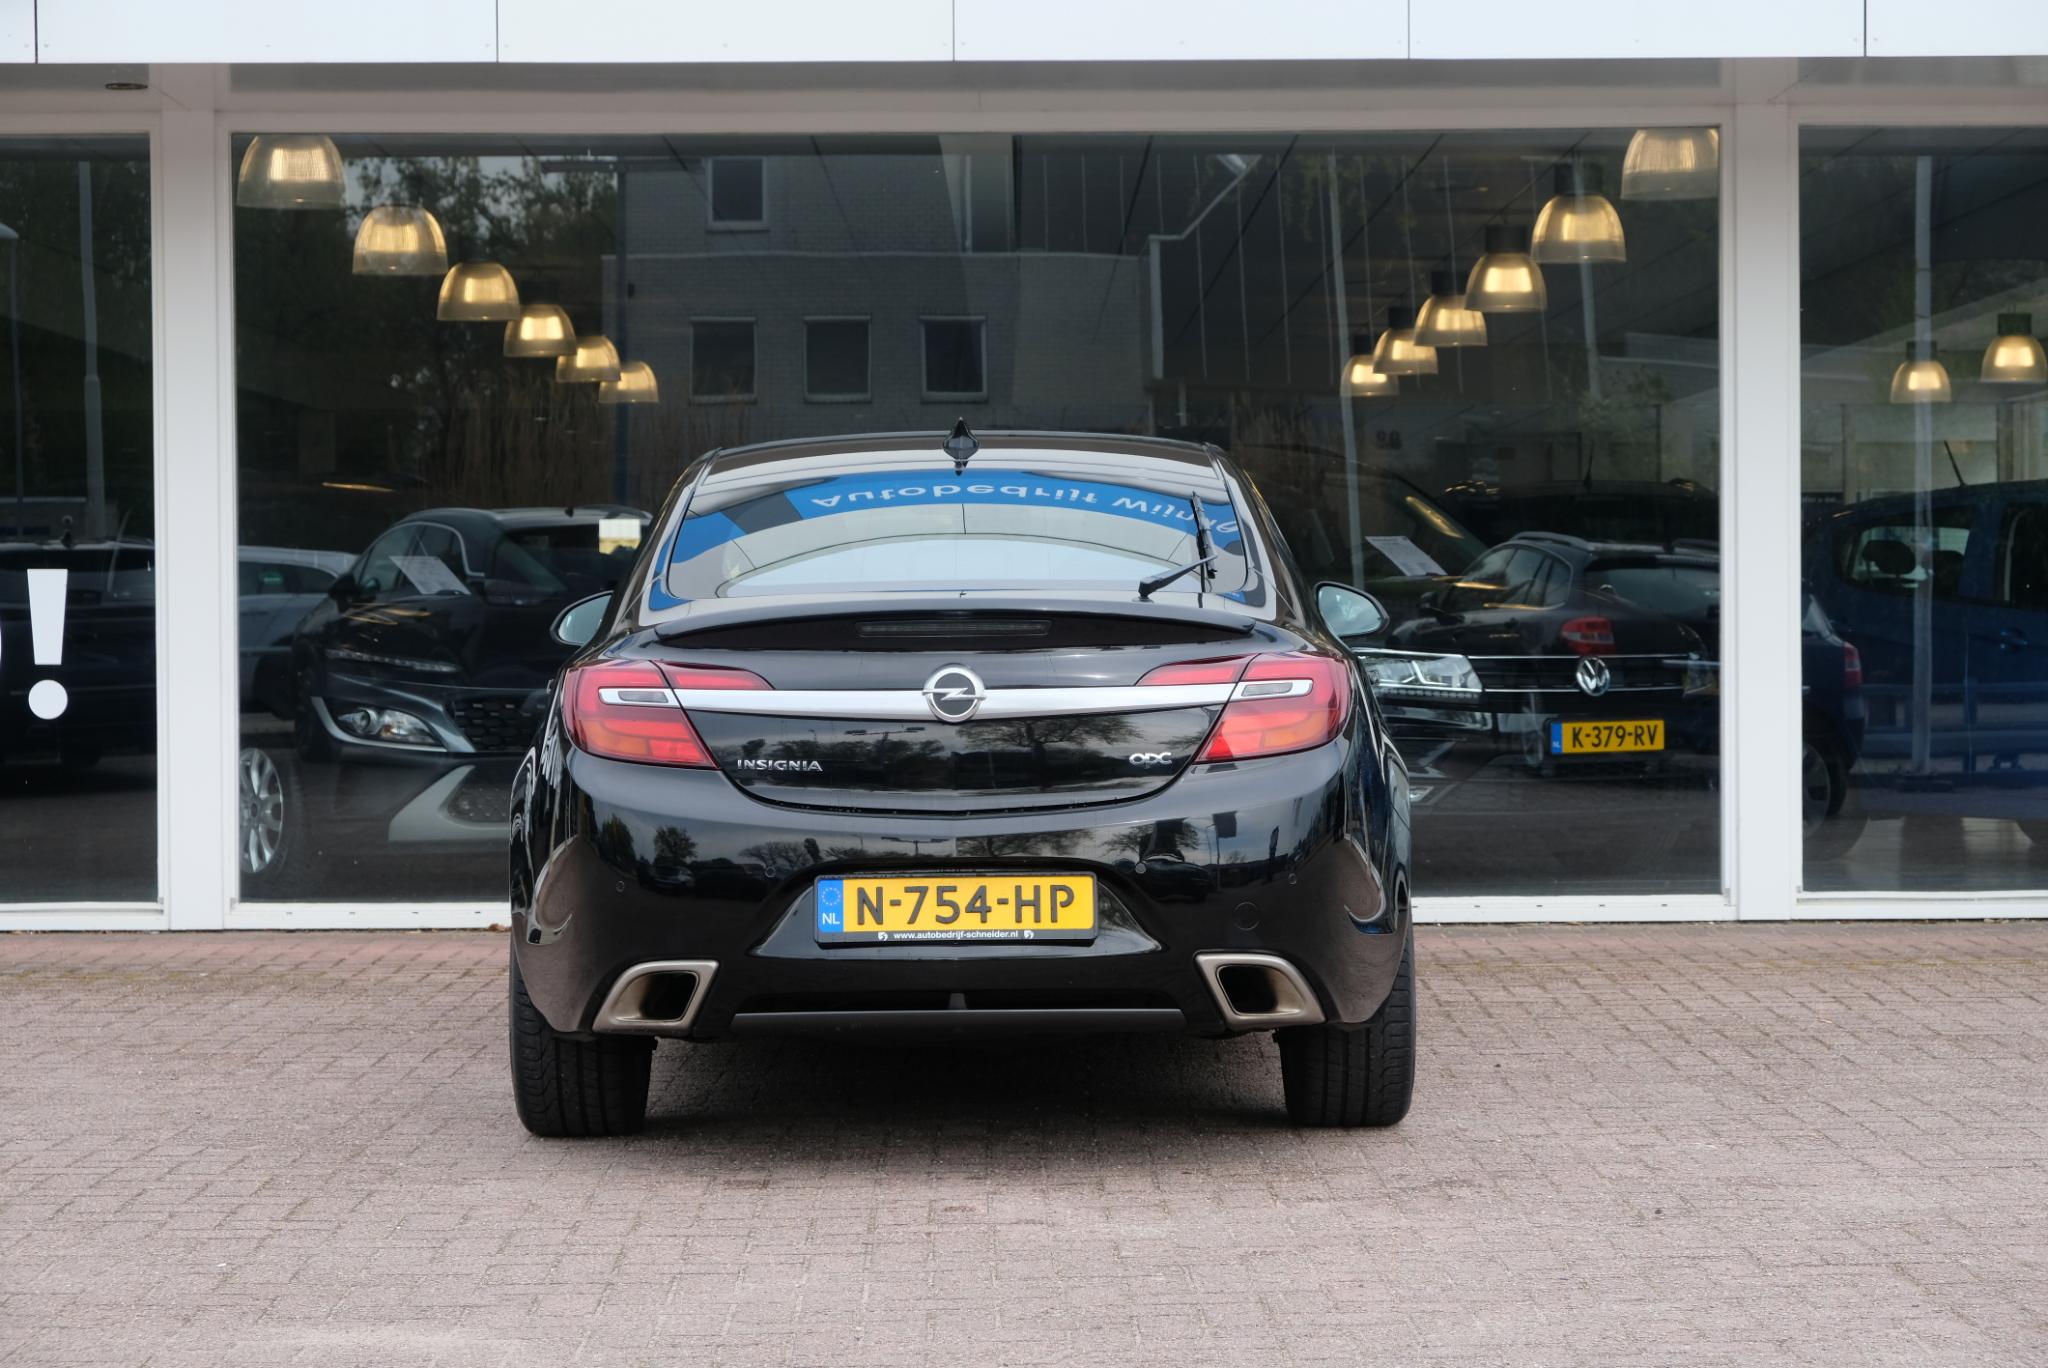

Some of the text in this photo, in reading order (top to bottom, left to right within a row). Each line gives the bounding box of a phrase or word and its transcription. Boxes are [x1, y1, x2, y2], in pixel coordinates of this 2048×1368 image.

[1572, 724, 1658, 748] K-379-RV
[737, 759, 823, 771] INSIGNIA
[1129, 752, 1172, 768] OPC
[822, 884, 1075, 925] NL N-754-HP
[893, 930, 1018, 940] www.autobedrijf-schneider.nl
